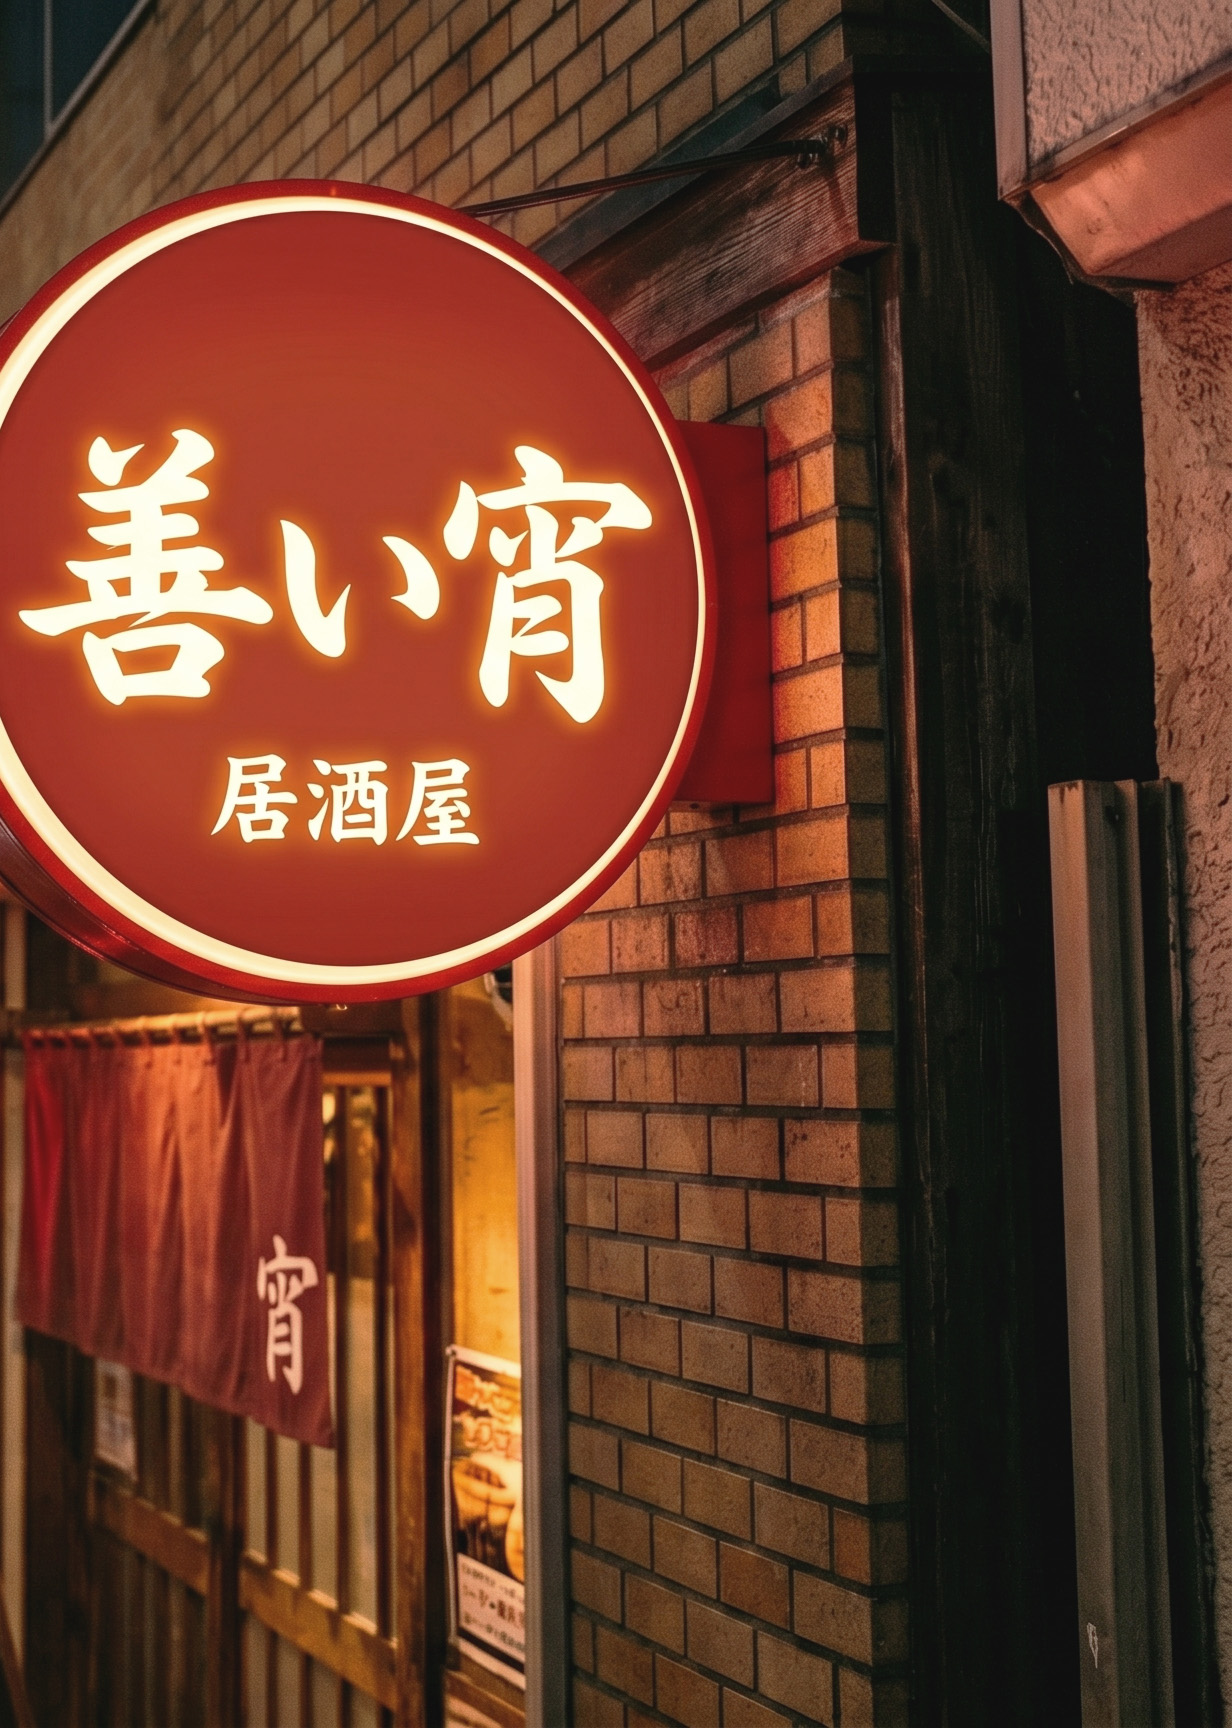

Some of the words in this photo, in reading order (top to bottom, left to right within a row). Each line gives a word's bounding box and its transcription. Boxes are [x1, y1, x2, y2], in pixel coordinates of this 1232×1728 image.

[18, 428, 653, 724] 善い宵
[211, 754, 480, 846] 居酒屋
[256, 1234, 319, 1396] 宵
